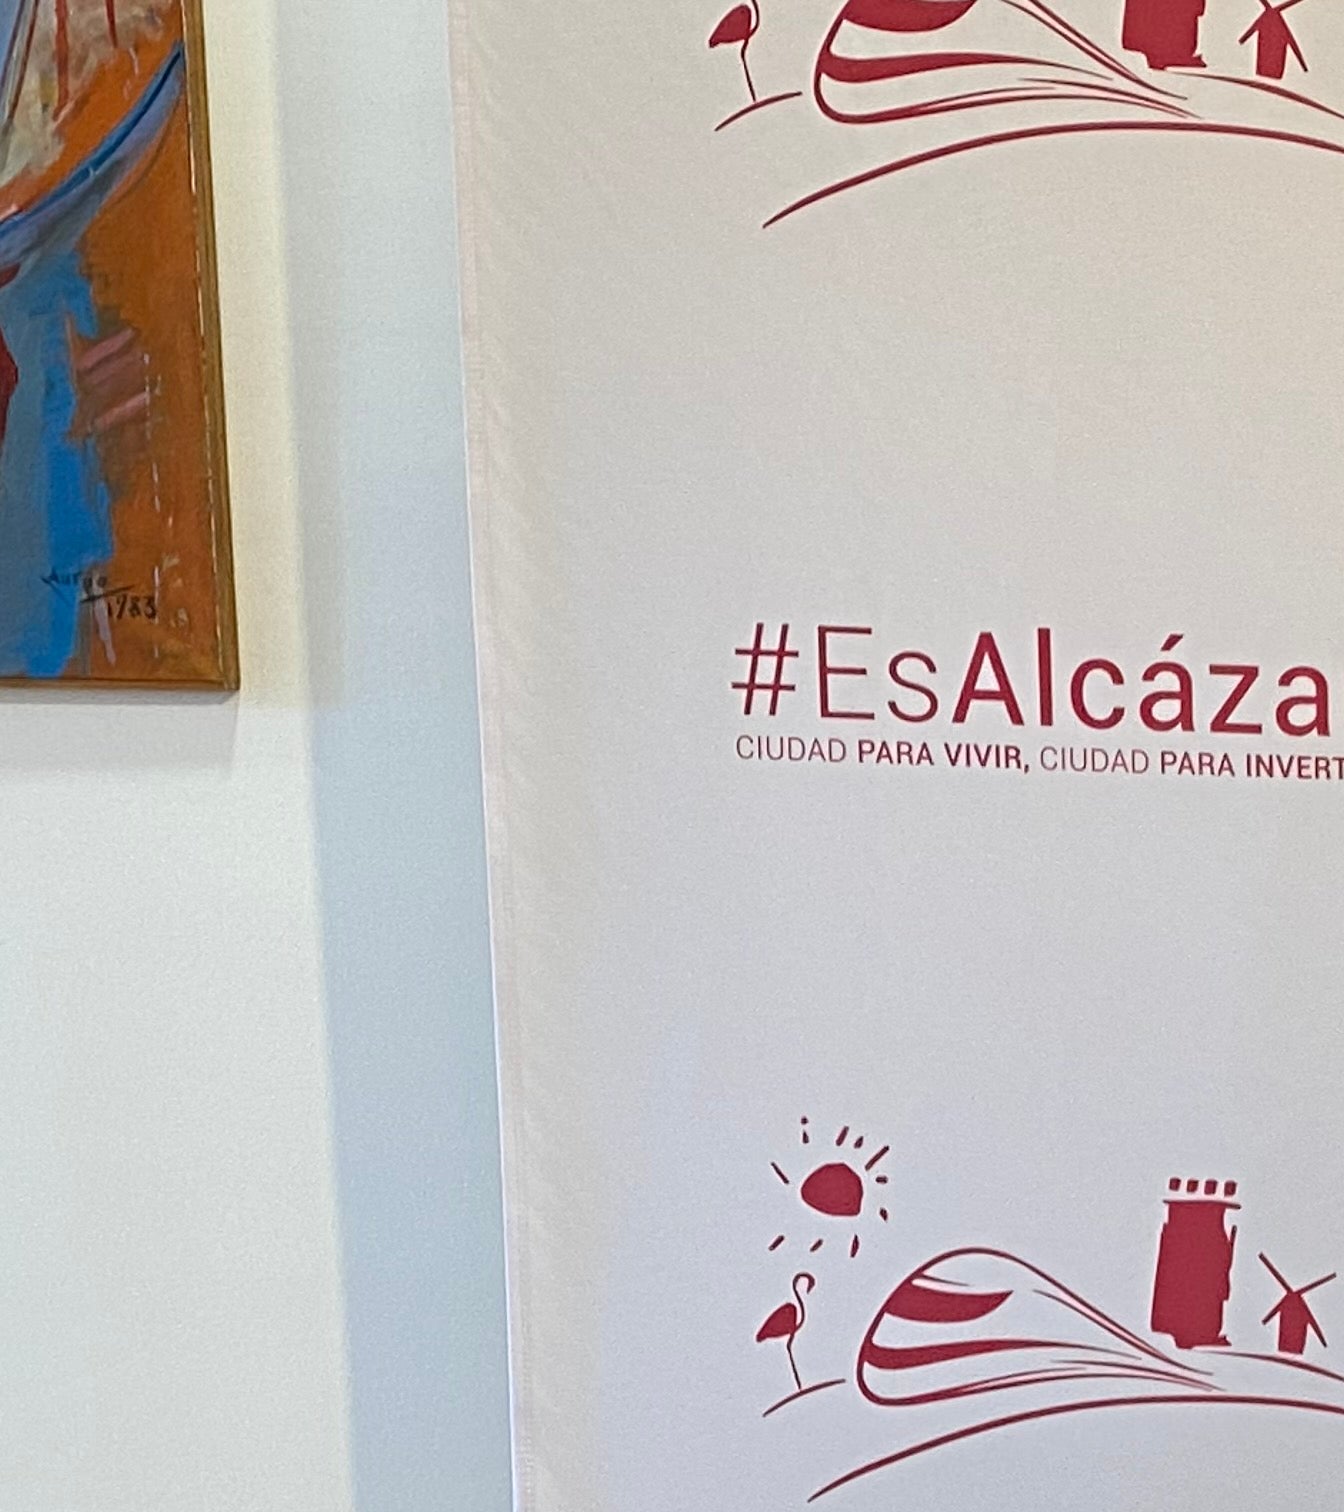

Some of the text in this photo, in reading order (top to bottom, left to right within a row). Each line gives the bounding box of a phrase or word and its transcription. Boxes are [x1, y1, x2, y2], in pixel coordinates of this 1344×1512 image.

[736, 736, 847, 763] CIUDAD
[858, 741, 934, 767] PARA
[944, 744, 1031, 774] VIVIR,
[1040, 747, 1150, 774] CIUDAD
[1161, 752, 1235, 777] PARA
